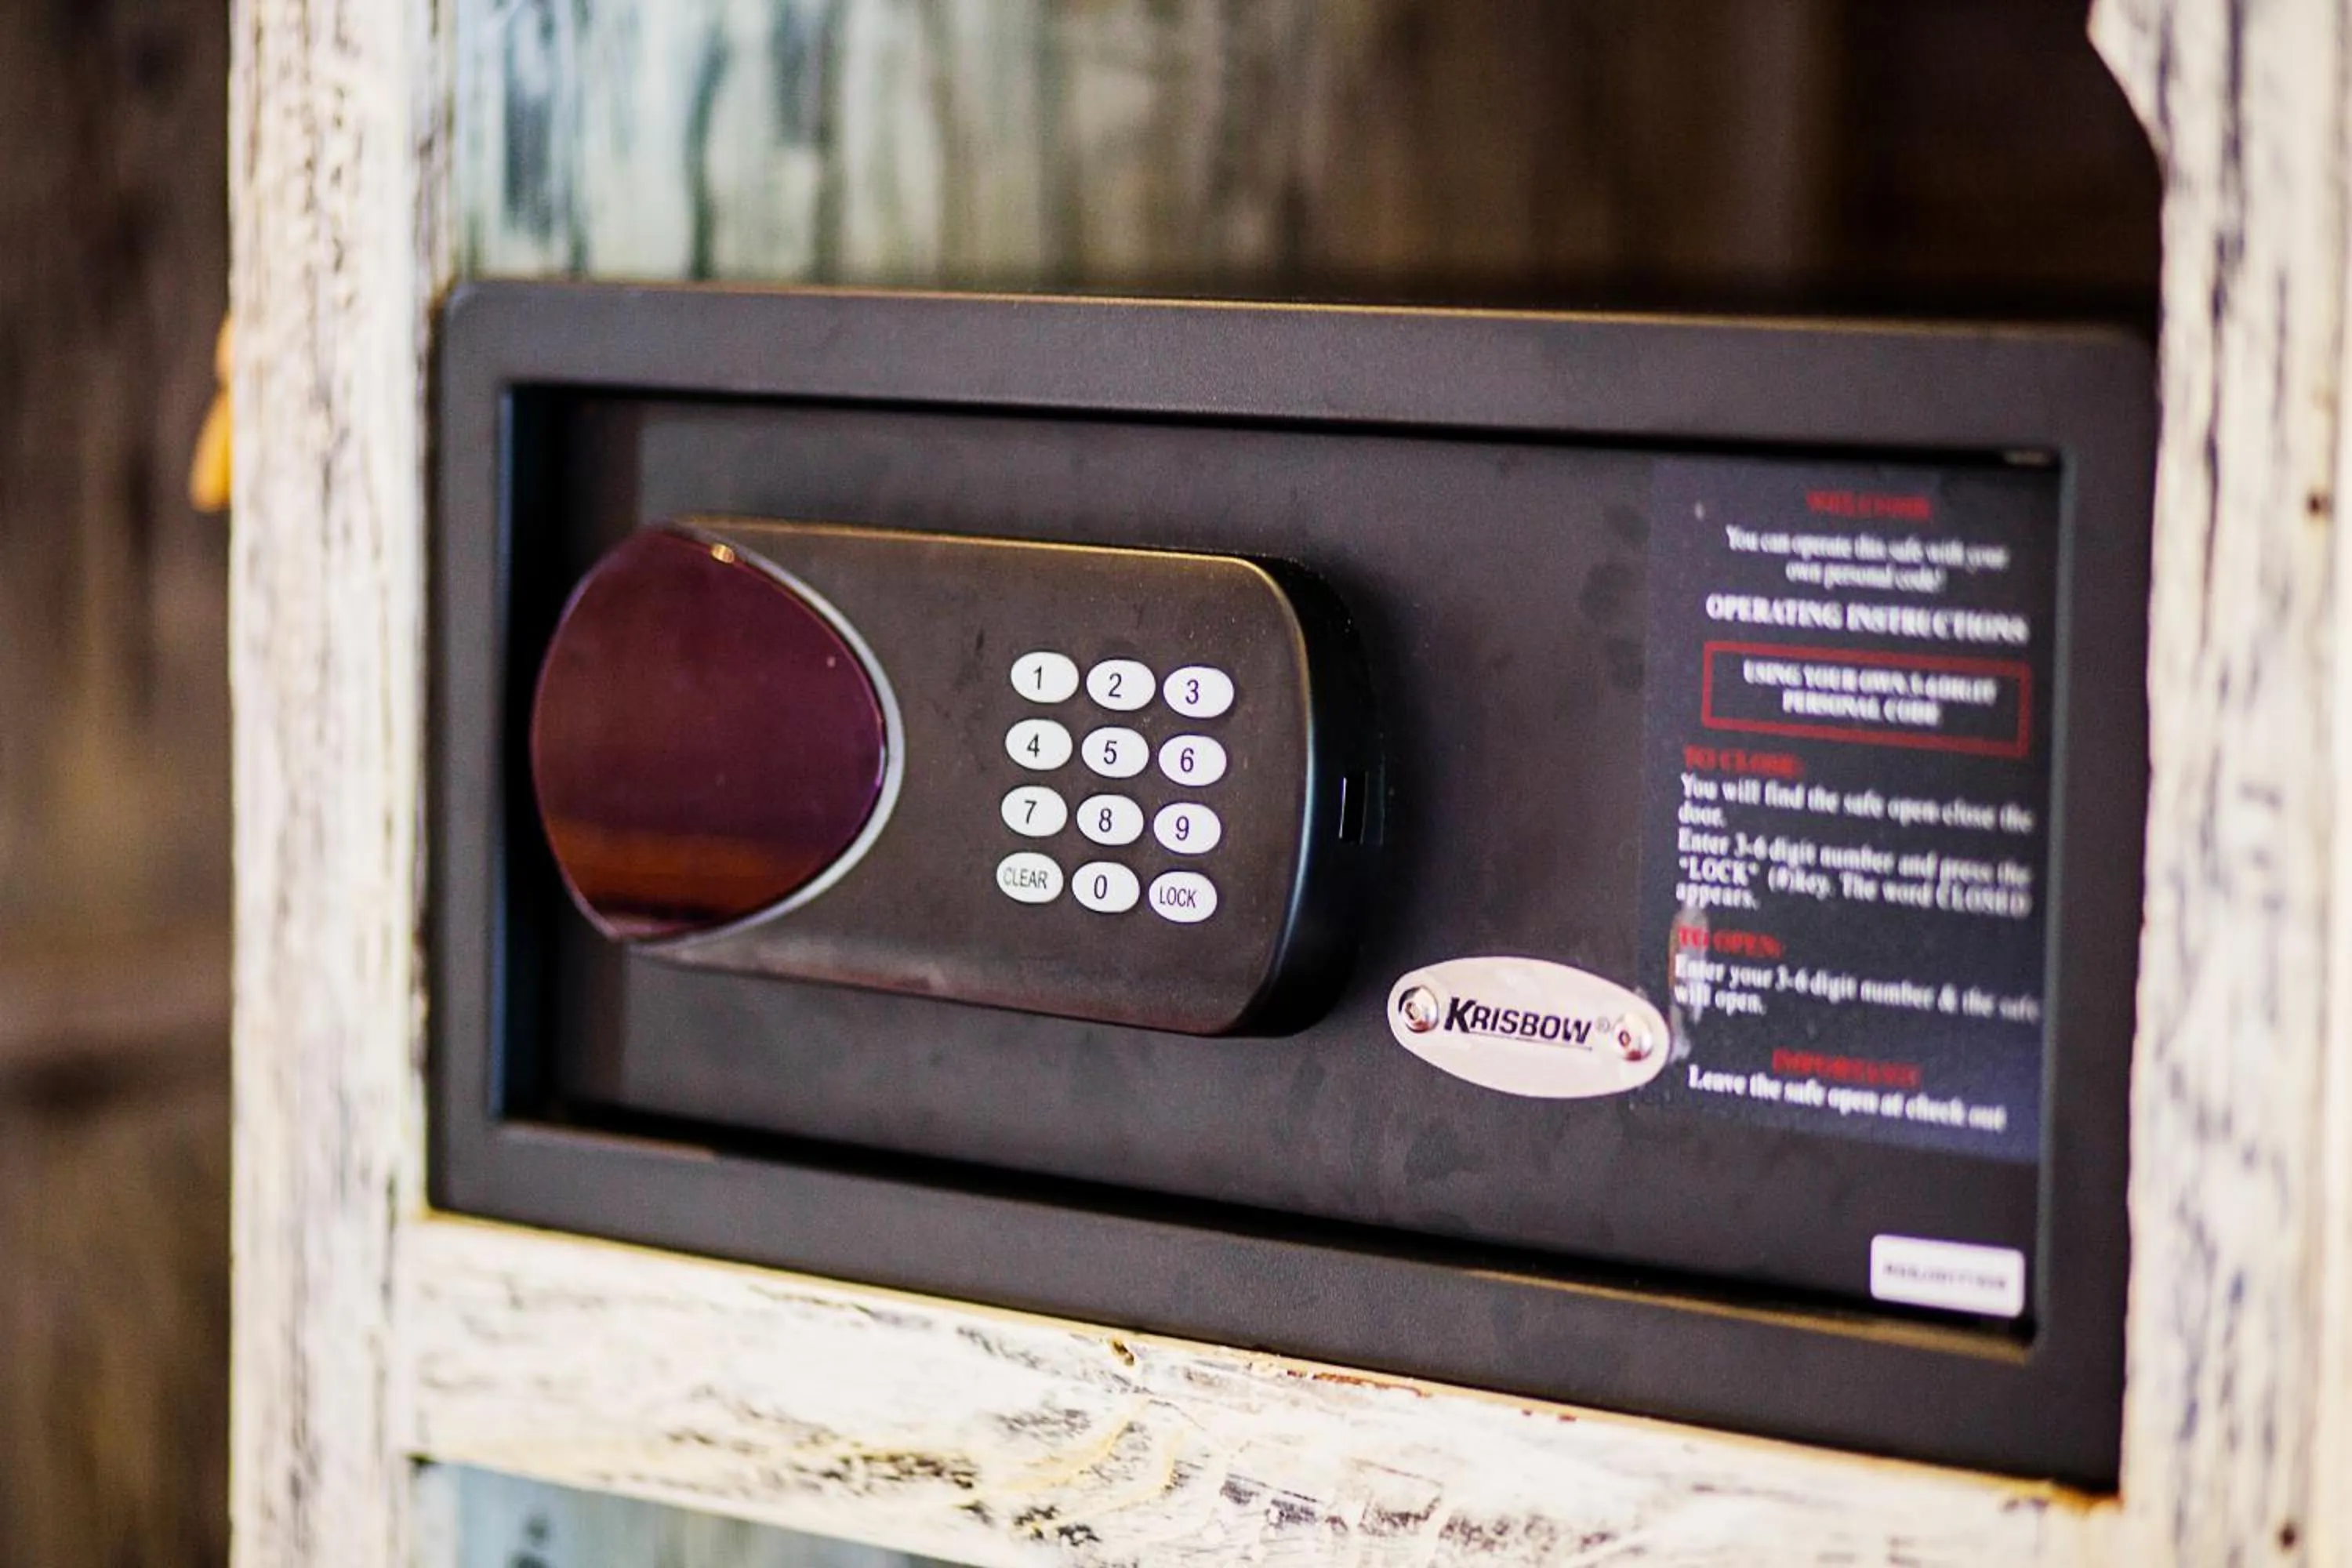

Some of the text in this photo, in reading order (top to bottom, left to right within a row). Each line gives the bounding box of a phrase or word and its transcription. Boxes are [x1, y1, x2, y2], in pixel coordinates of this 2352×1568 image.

[1726, 524, 1759, 550] You
[1705, 593, 2030, 644] OPERATING INSTRUCTIONS
[1033, 666, 1200, 705] 1 2 3
[1026, 734, 1195, 773] 4 5 6
[1024, 800, 1190, 841] 7 8 9
[1679, 800, 1728, 827] door.
[1680, 772, 1719, 800] You
[1722, 778, 1760, 805] will
[1765, 779, 1804, 811] find
[1807, 785, 1840, 815] the
[1843, 789, 1883, 819] safe
[1999, 804, 2034, 834] the
[1678, 827, 1730, 855] Enter
[1820, 844, 1895, 876] number
[1897, 850, 1938, 880] and
[1002, 866, 1196, 909] CLEAR 0 LOCK
[1839, 871, 1878, 901] The
[1882, 879, 1934, 909] word
[1675, 953, 1725, 982] Enter
[1729, 965, 1773, 989] your
[1860, 979, 1936, 1011] number
[1938, 982, 1958, 1014] &
[1962, 988, 1995, 1018] the
[1715, 989, 1766, 1017] open.
[1443, 996, 1592, 1044] KRISBOW
[1688, 1065, 1747, 1095] Leave
[1749, 1072, 1782, 1099] the
[1784, 1077, 1827, 1106] safe
